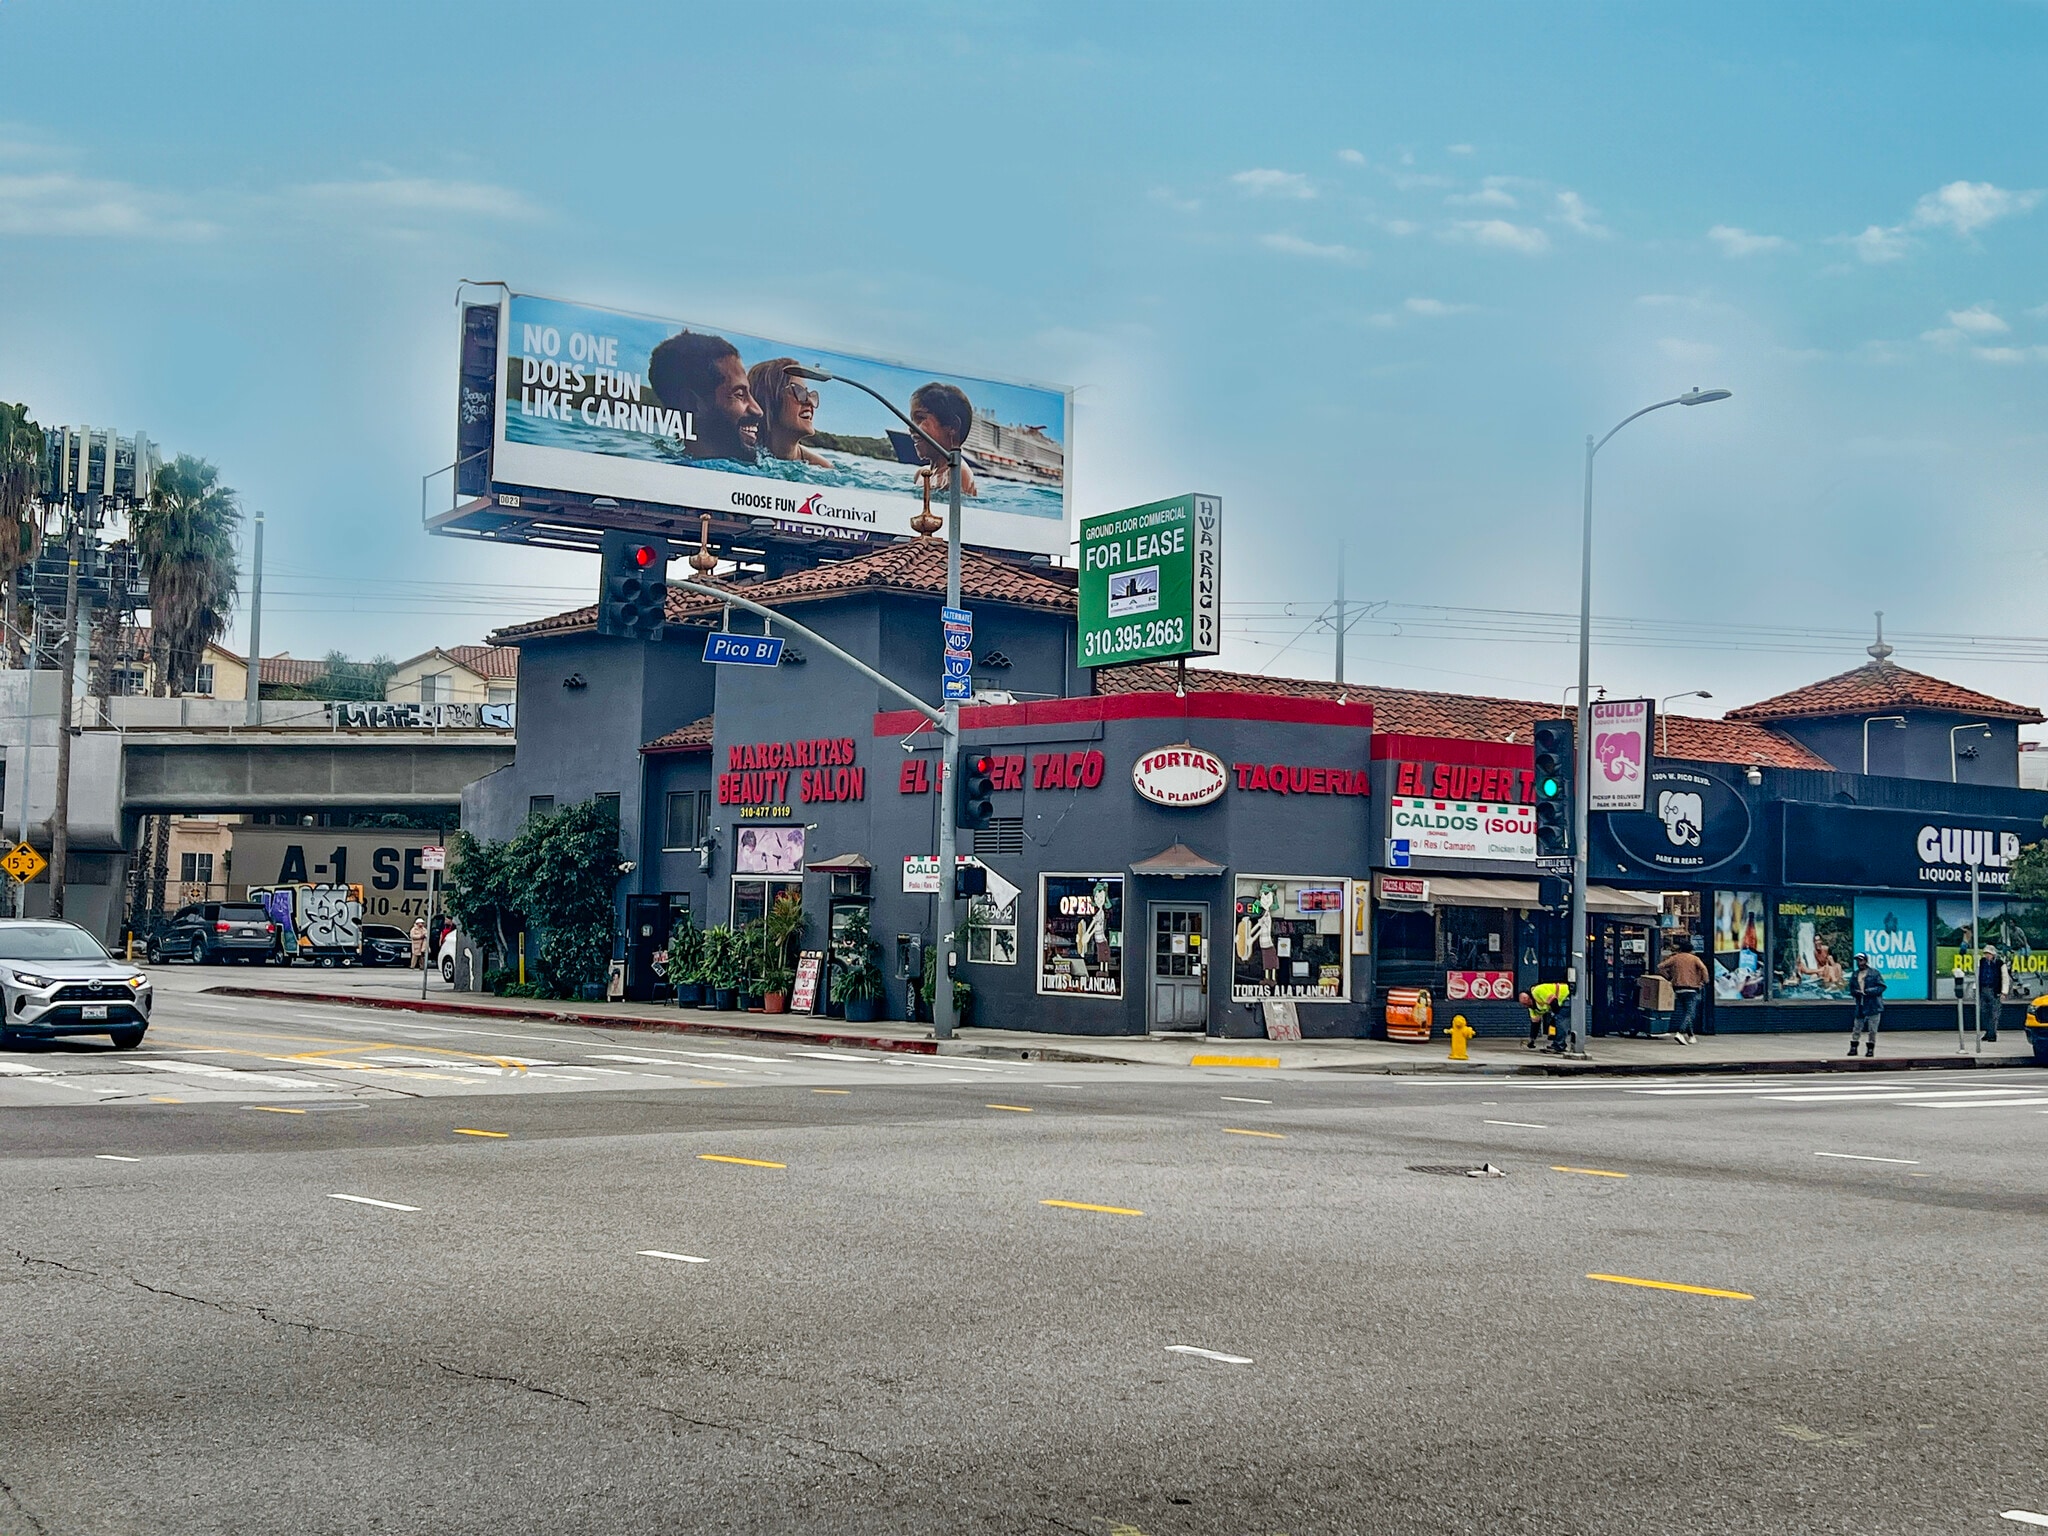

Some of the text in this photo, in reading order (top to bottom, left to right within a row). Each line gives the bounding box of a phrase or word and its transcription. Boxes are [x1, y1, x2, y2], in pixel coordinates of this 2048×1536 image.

[523, 324, 618, 367] NO ONE
[522, 355, 641, 402] DOES FUN
[521, 386, 573, 422] LIKE
[580, 397, 697, 441] CARNIVAL
[500, 496, 519, 506] 0023
[731, 491, 796, 513] CHOOSE FUN
[816, 503, 876, 524] Carnival
[1085, 506, 1186, 541] GROUND FLOOR COMMERCIAL
[1086, 527, 1185, 571] FOR LEASE
[943, 610, 971, 623] ALTERNATE
[949, 635, 967, 647] 405
[1085, 617, 1184, 656] 310.395.2663
[714, 640, 749, 658] Pico
[952, 662, 963, 674] 10
[1594, 703, 1644, 719] GUULP
[899, 759, 929, 793] EL
[1032, 750, 1105, 789] TACO
[1142, 752, 1219, 777] TORTAS
[718, 767, 864, 804] BEAUTY SALON
[1138, 777, 1223, 802] A LA PLANCHA
[1233, 762, 1370, 796] TAQUERIA
[1396, 762, 1536, 803] EL SUPER T
[772, 806, 791, 817] 0119
[1395, 813, 1478, 831] CALDOS
[1917, 826, 2020, 867] GUULP
[278, 845, 347, 885] A-1
[1655, 854, 1672, 864] PARK
[1681, 857, 1697, 865] REAR
[1919, 868, 2010, 885] LIQUOR & MARKE
[1236, 902, 1259, 914] OEN
[1778, 903, 1807, 915] BRING
[1815, 904, 1846, 917] ALOHA
[1864, 929, 1916, 954] KONA
[1886, 954, 1918, 969] WAVE
[2012, 955, 2048, 973] ALOH
[1080, 976, 1116, 993] PLANCHA
[1234, 985, 1271, 997] TORTAS
[1296, 985, 1337, 997] PLANCHA
